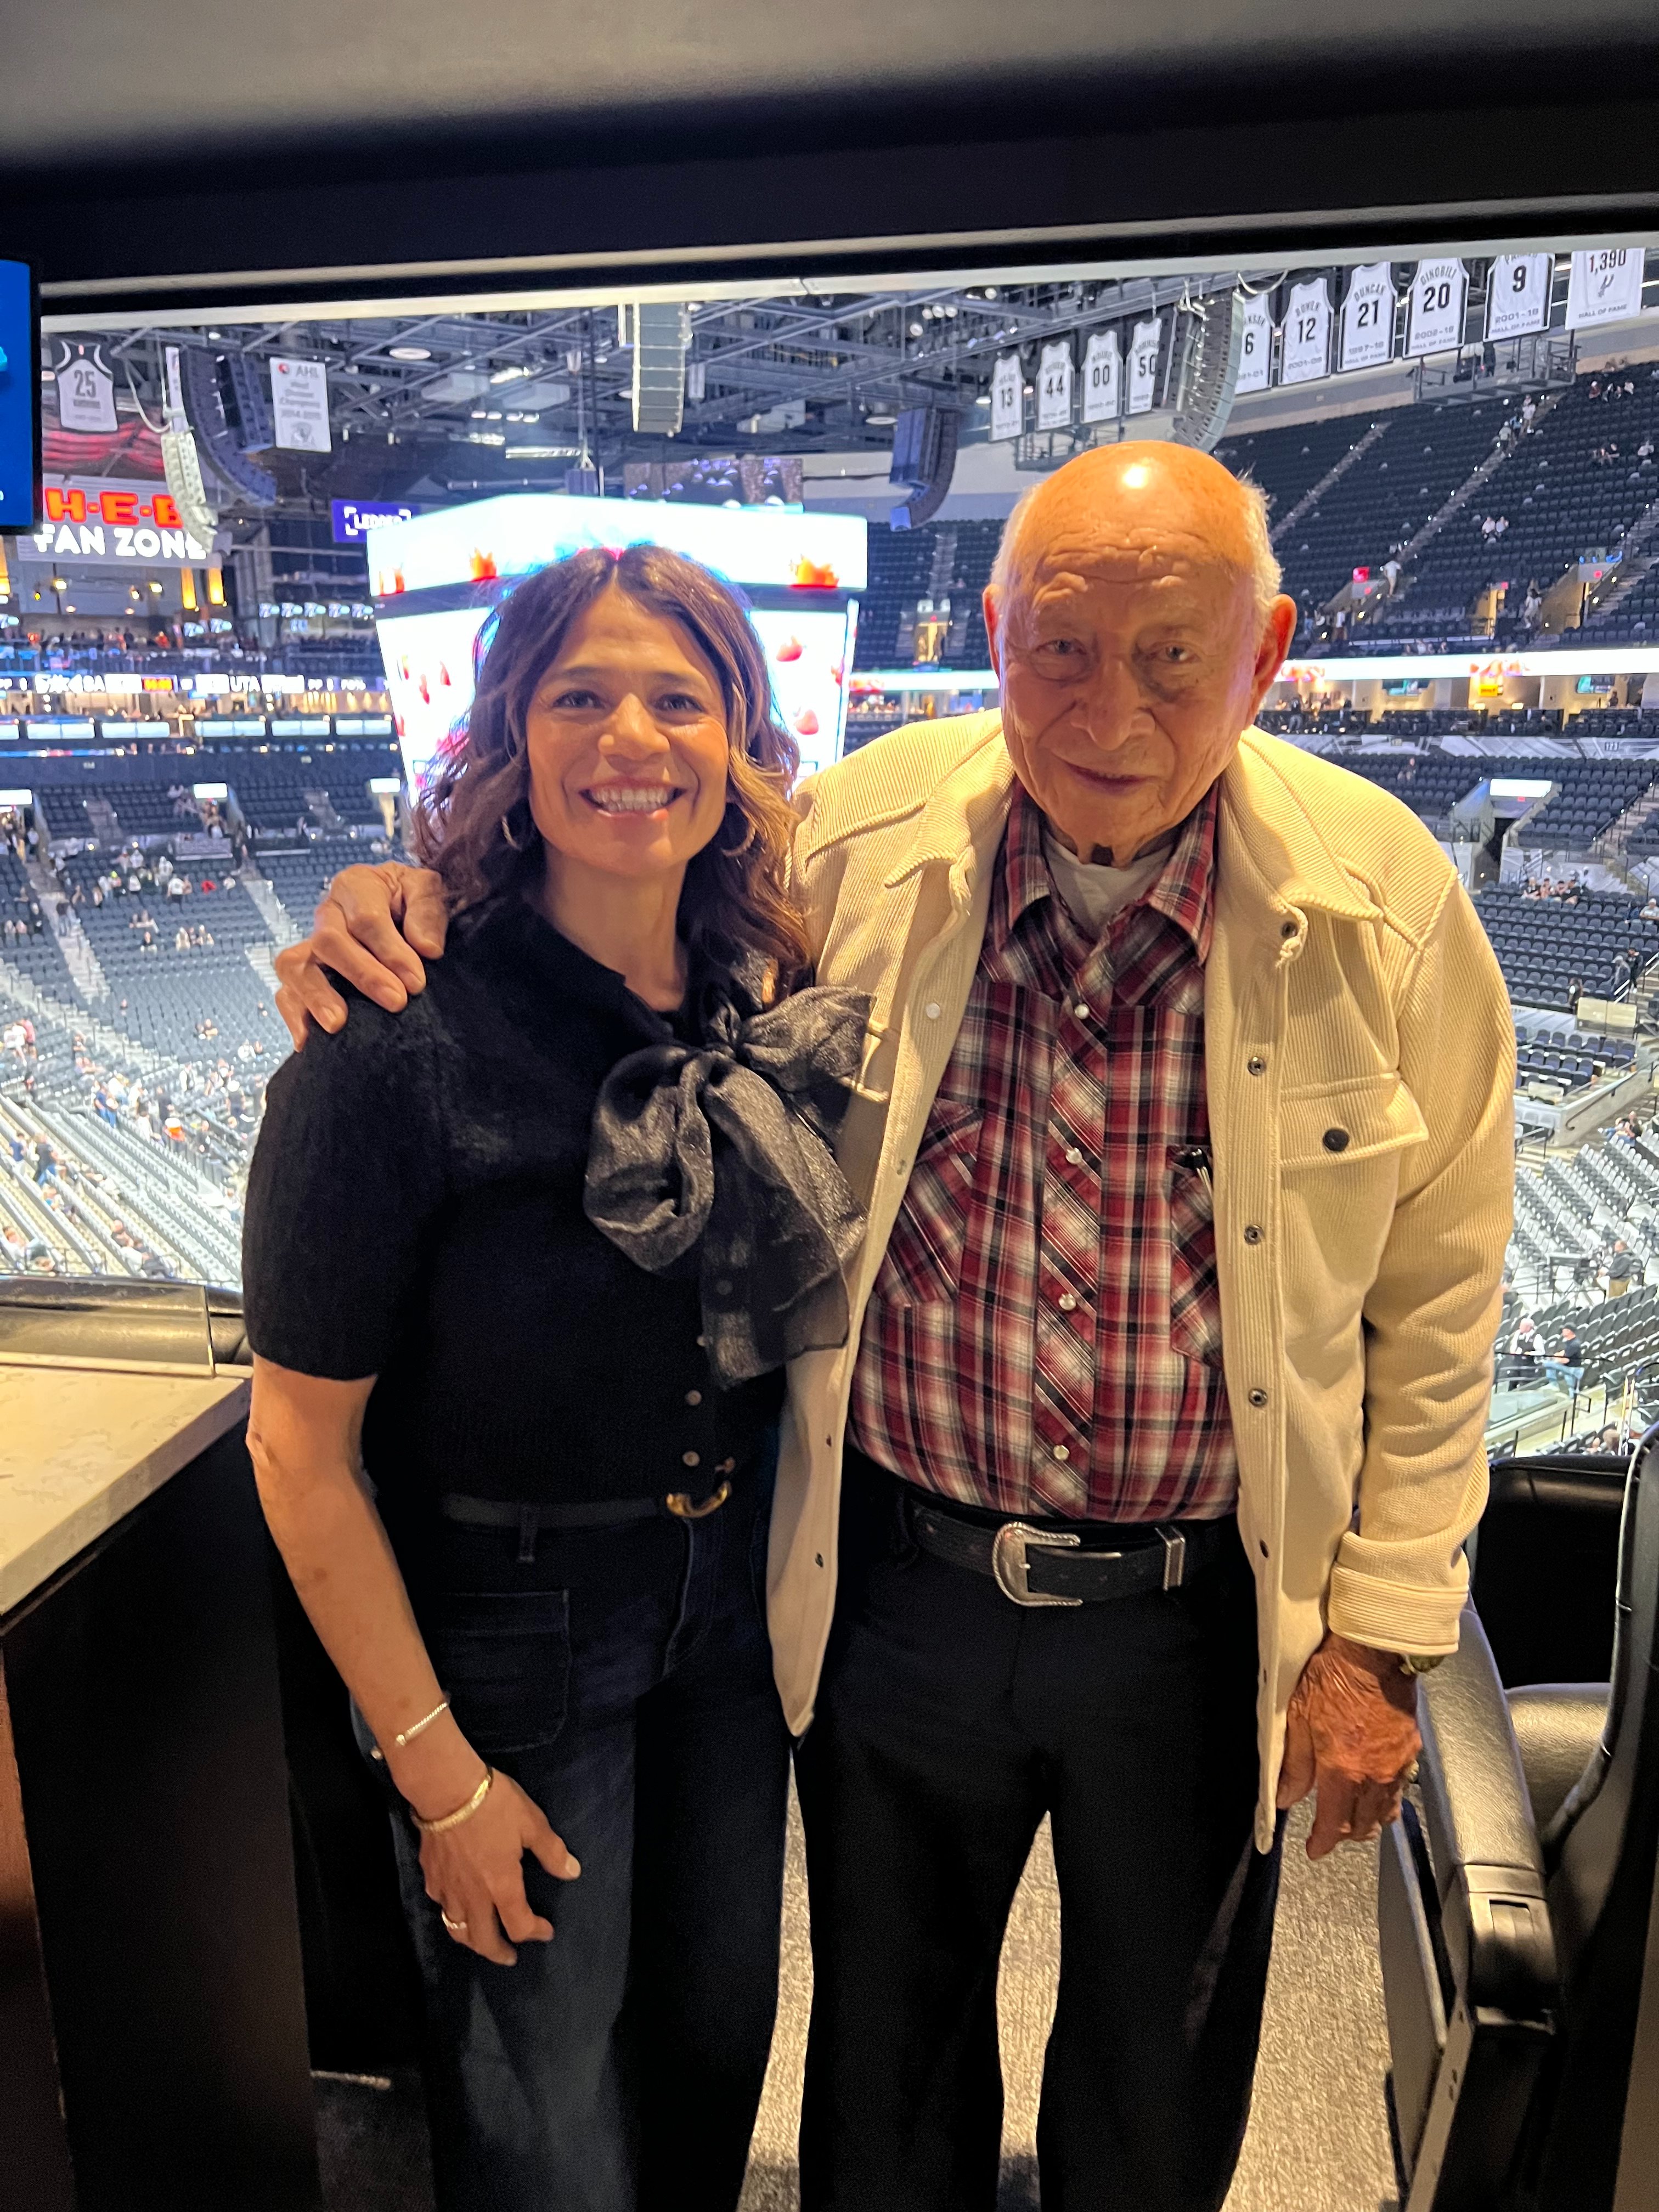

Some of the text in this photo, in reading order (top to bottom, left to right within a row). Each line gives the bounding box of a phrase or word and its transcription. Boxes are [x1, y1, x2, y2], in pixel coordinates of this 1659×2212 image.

[1420, 265, 1458, 286] GINOBILI
[1513, 264, 1527, 292] 9
[1353, 284, 1386, 302] DUNCAN
[1423, 282, 1451, 314] 20
[1357, 299, 1380, 329] 21
[1607, 303, 1628, 312] FAME
[1298, 318, 1316, 343] 12
[1245, 332, 1254, 355] 6
[1093, 364, 1110, 388] 00
[1138, 354, 1157, 377] 50
[74, 369, 97, 398] 25
[1046, 375, 1064, 398] 44
[1001, 387, 1013, 409] 13
[34, 523, 105, 555] FAN
[230, 675, 261, 692] UTA
